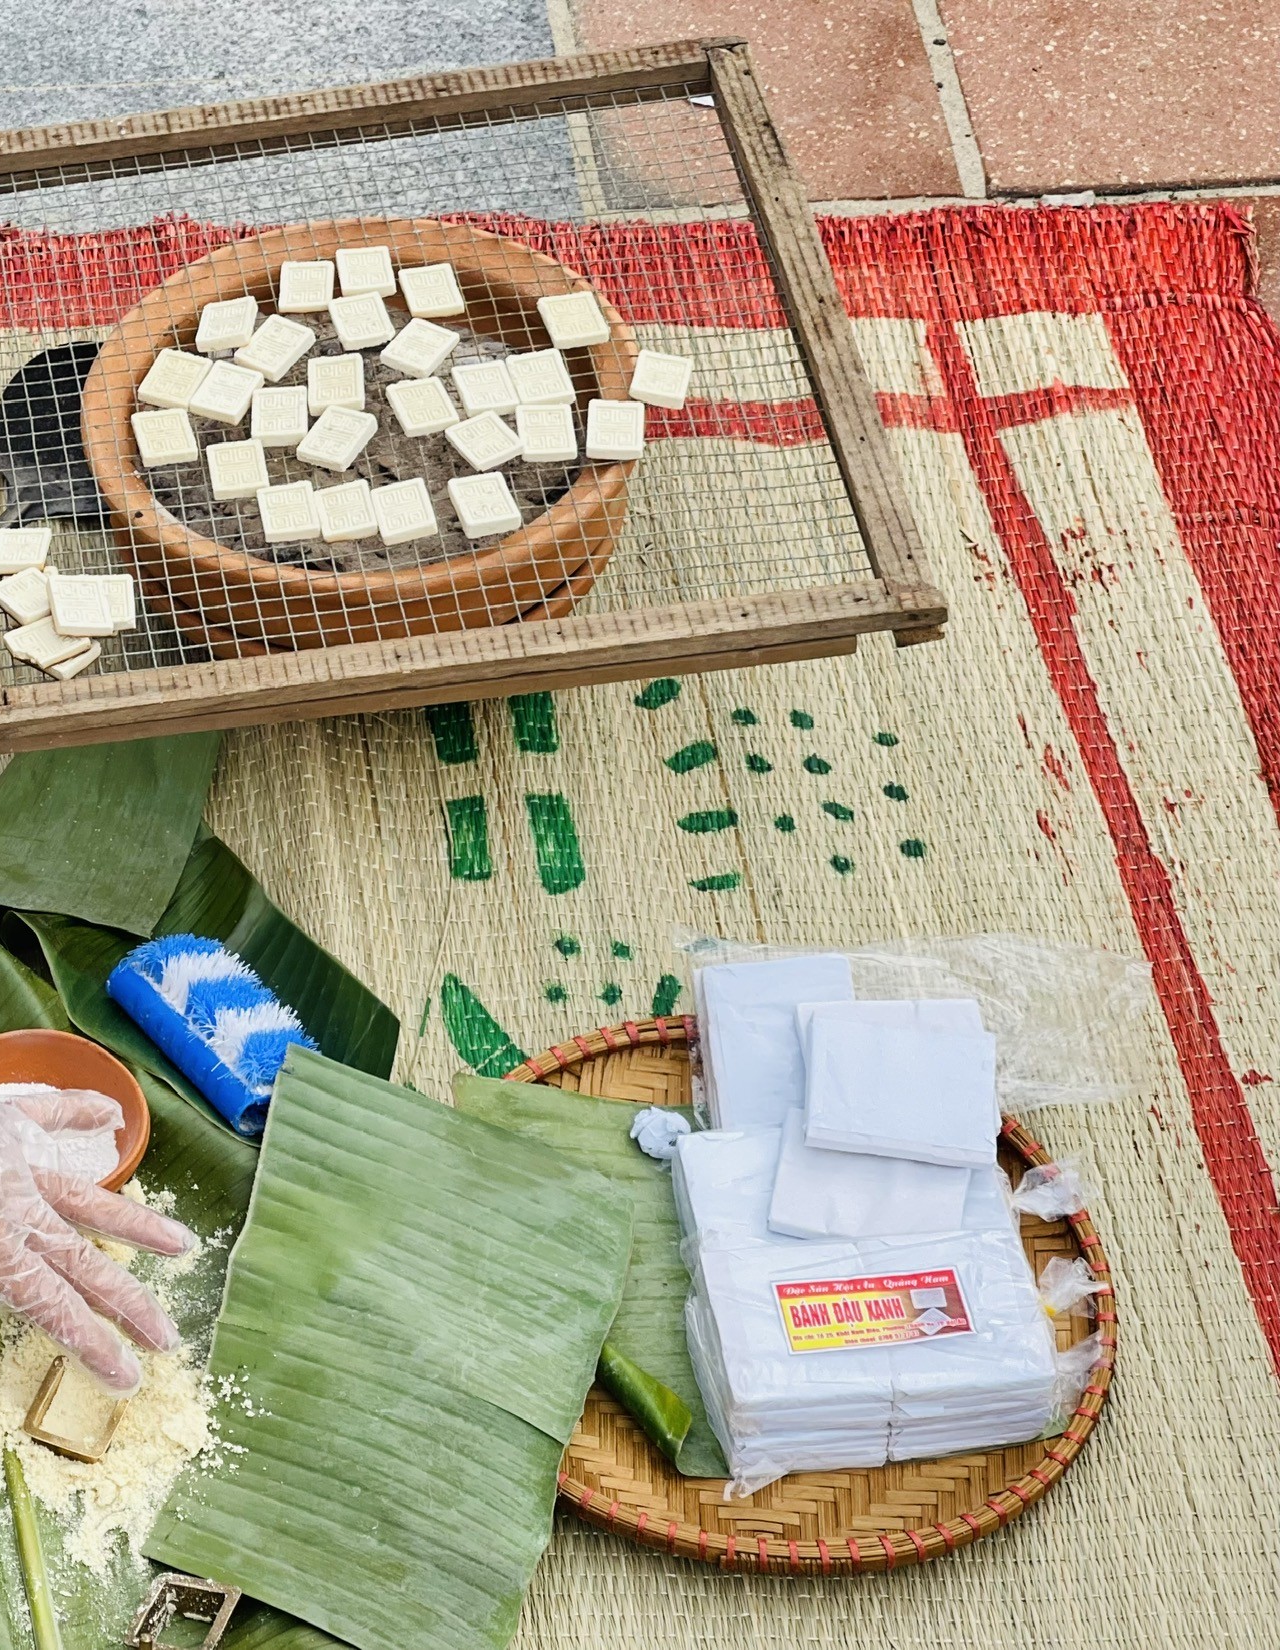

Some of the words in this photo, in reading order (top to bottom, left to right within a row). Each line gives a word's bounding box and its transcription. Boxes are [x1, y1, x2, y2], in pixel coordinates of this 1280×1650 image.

[789, 1300, 831, 1328] BÁNH
[832, 1297, 864, 1327] ĐẬU
[864, 1297, 905, 1321] XANH
